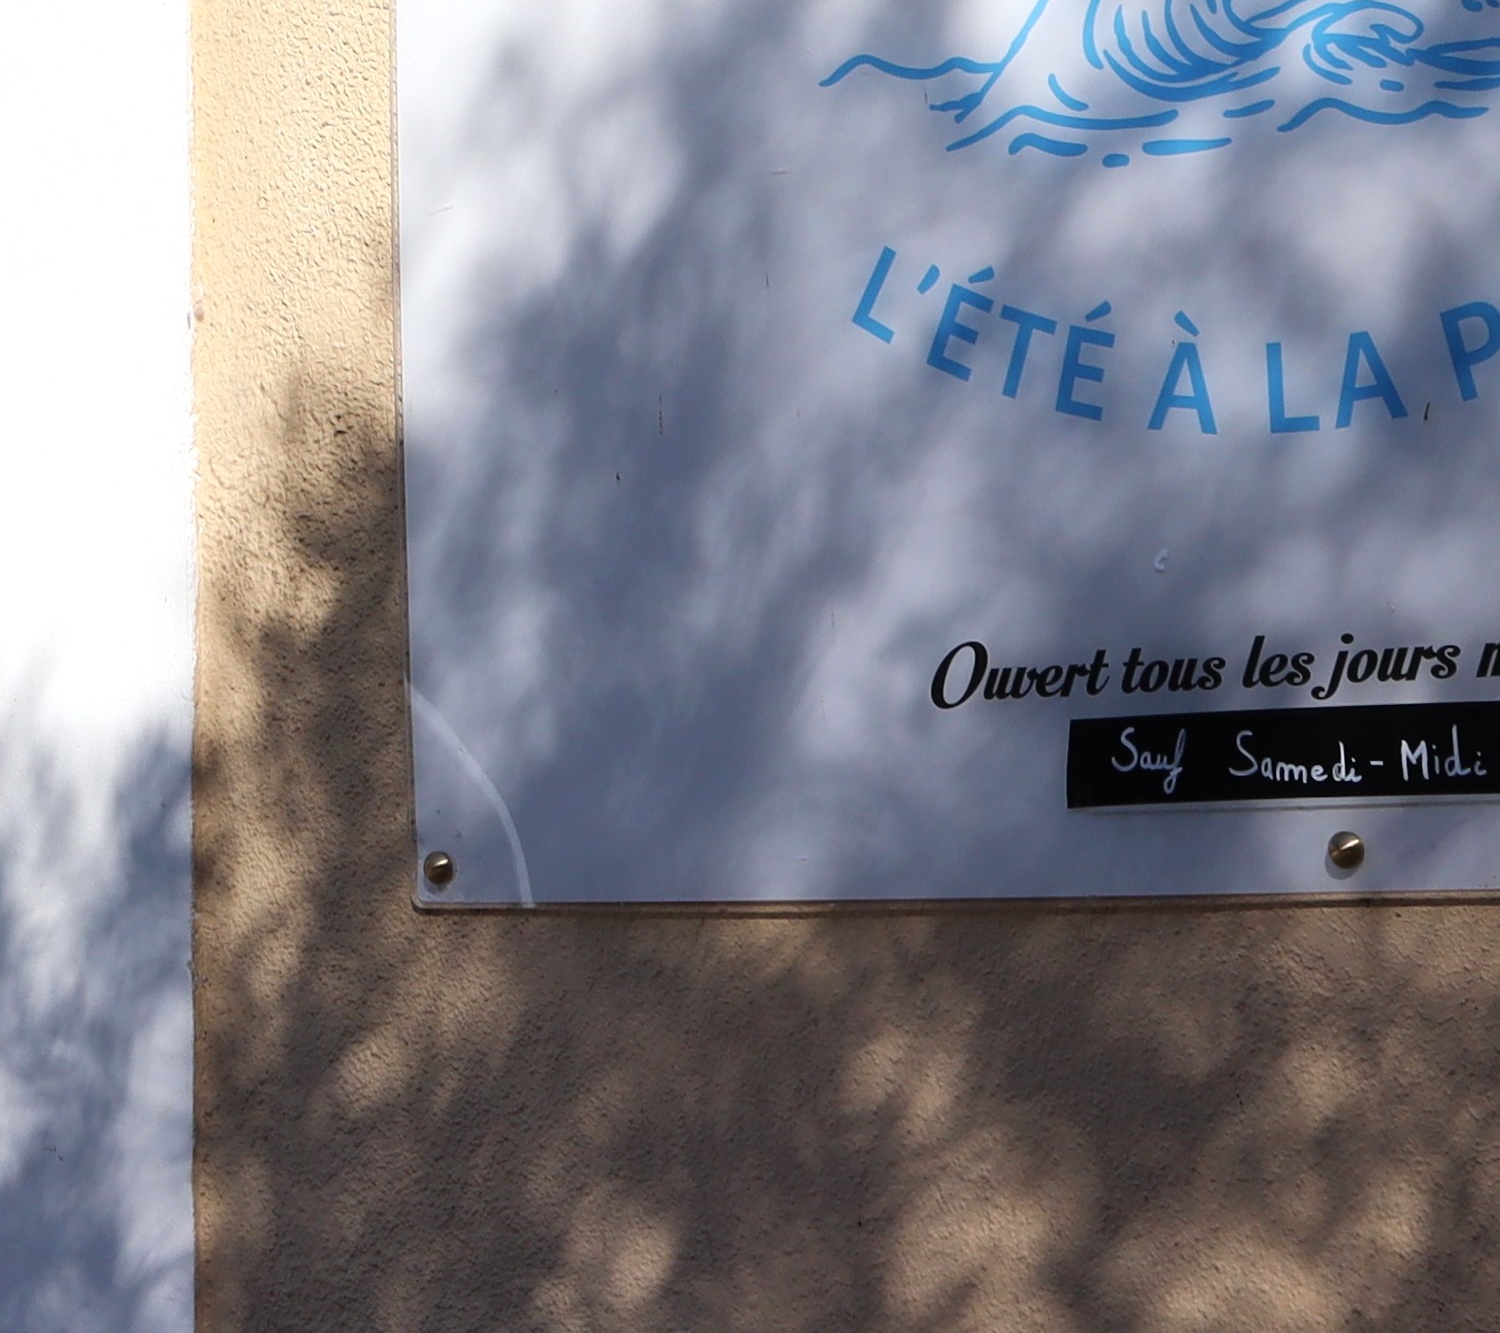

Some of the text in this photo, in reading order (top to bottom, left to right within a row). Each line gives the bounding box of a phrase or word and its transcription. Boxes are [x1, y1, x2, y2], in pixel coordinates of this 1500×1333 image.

[851, 245, 1117, 422] L'ÉTÉ
[1147, 310, 1219, 436] À
[1265, 330, 1408, 435] LA
[929, 640, 1111, 711] Ouvert
[1121, 646, 1228, 695] tous
[1241, 634, 1316, 690] les
[1310, 632, 1462, 702] jours
[1110, 726, 1187, 795] Sauf
